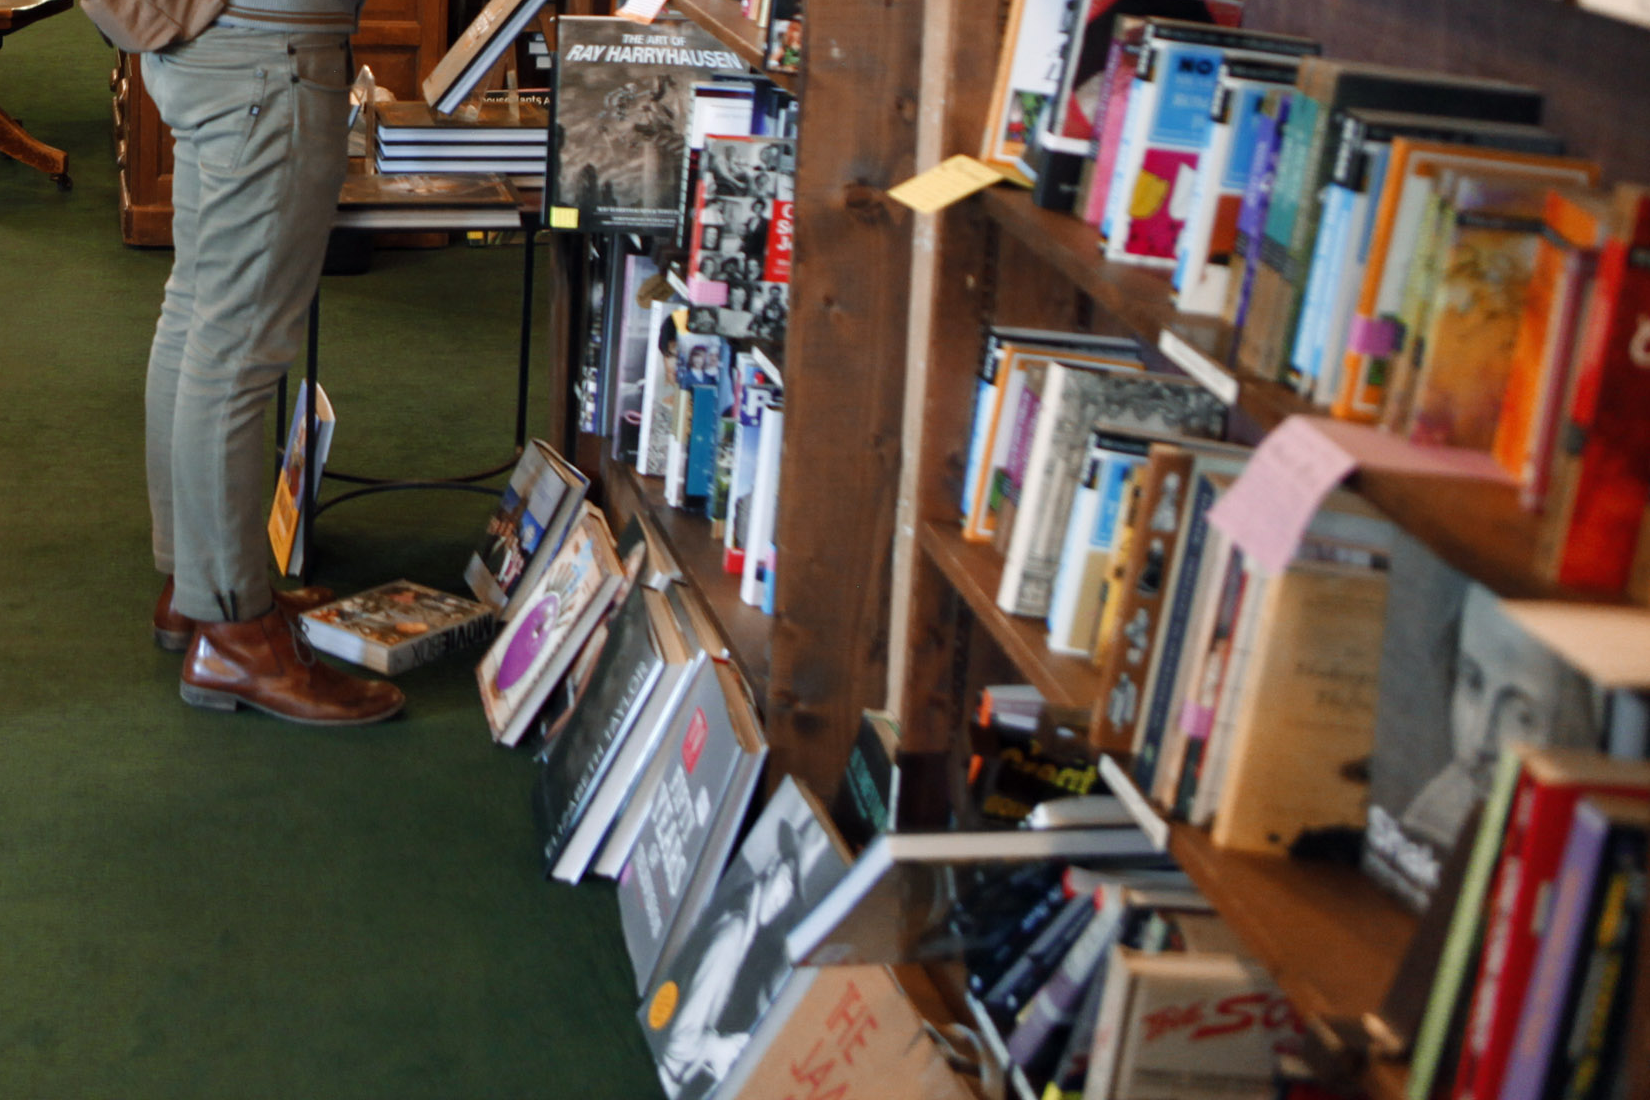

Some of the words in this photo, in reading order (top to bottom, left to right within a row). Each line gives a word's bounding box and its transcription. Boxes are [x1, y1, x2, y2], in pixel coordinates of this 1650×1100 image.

[622, 33, 644, 44] THE
[647, 34, 668, 45] ART
[670, 36, 687, 46] OF
[565, 43, 607, 62] RAY
[604, 45, 744, 70] HARRYHAUSEN
[544, 742, 605, 860] ELIZABETH
[603, 660, 649, 742] TAYLOR
